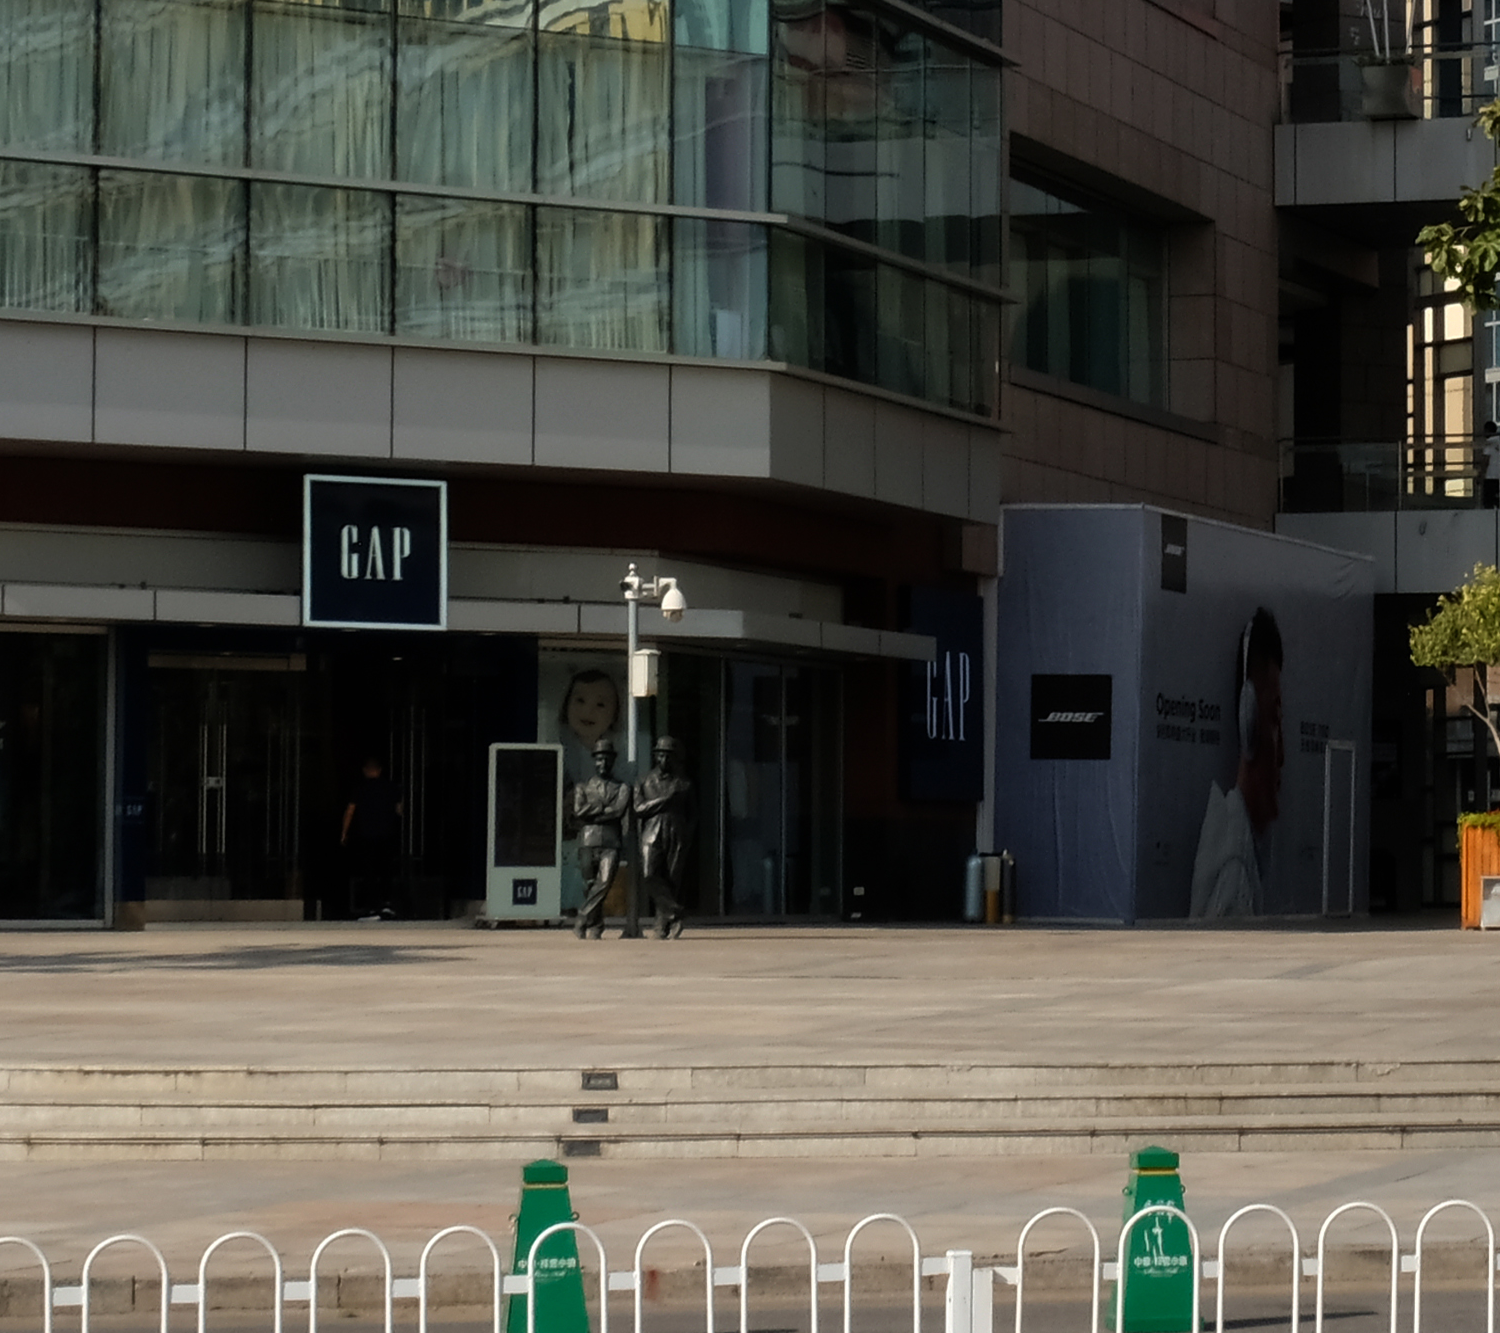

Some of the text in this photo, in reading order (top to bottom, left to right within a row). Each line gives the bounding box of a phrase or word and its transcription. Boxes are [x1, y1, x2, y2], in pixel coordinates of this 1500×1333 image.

[340, 524, 411, 581] GAP
[927, 650, 970, 741] GAP
[1038, 711, 1104, 723] BOSE
[1156, 692, 1221, 723] Opening Soon
